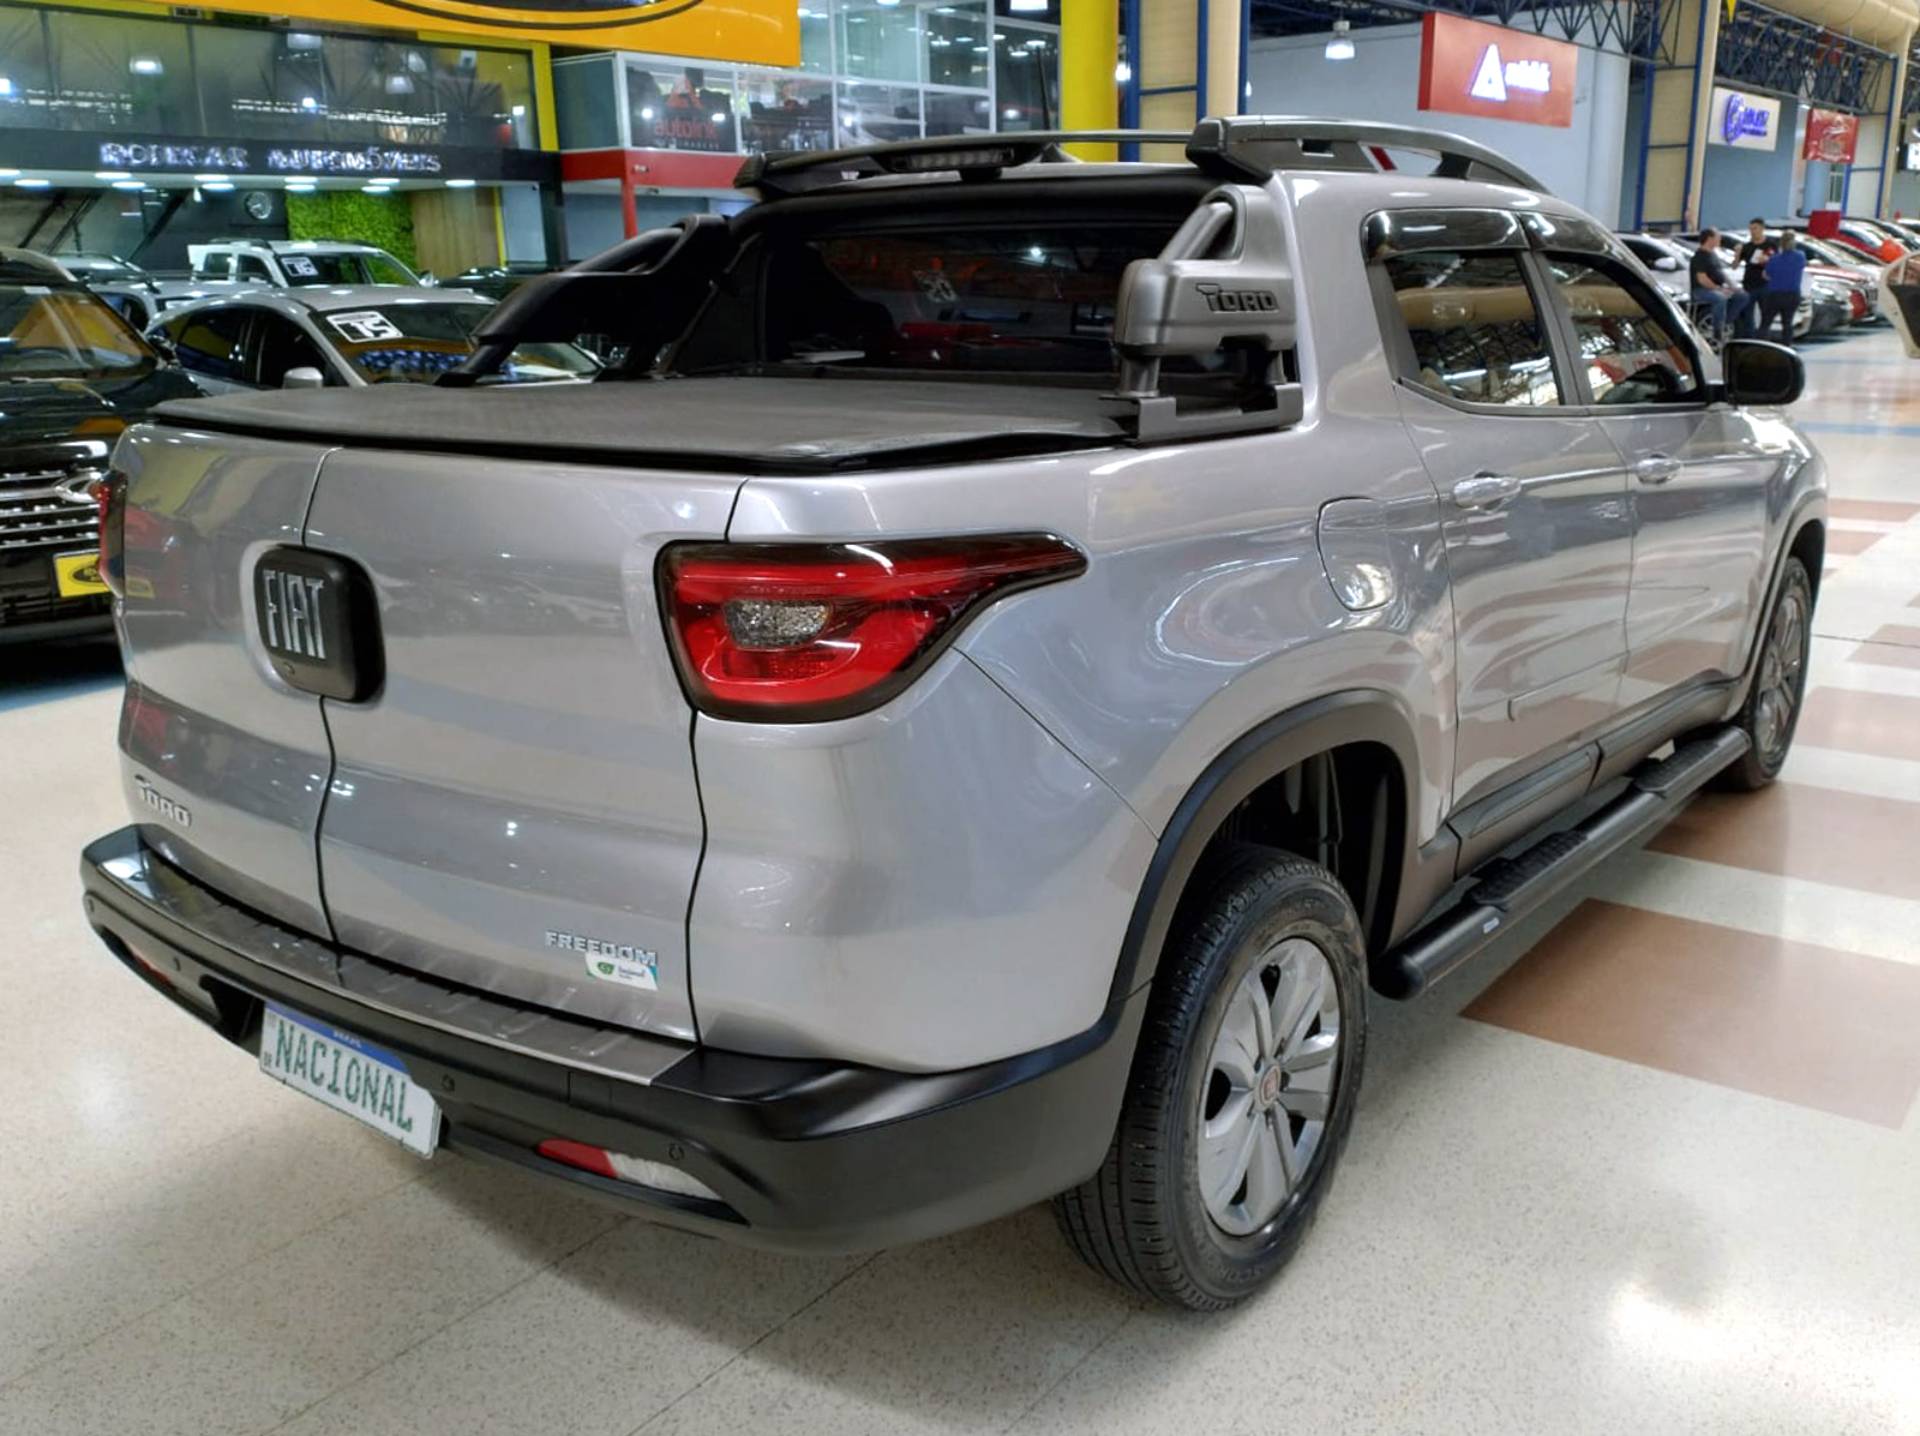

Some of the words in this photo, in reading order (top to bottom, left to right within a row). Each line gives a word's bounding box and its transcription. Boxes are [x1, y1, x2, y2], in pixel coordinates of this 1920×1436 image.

[1195, 282, 1280, 314] TORO
[262, 568, 326, 660] FIAT
[134, 774, 192, 828] TORO
[545, 930, 657, 967] FREEDOM
[274, 1019, 413, 1133] NACIONAL
